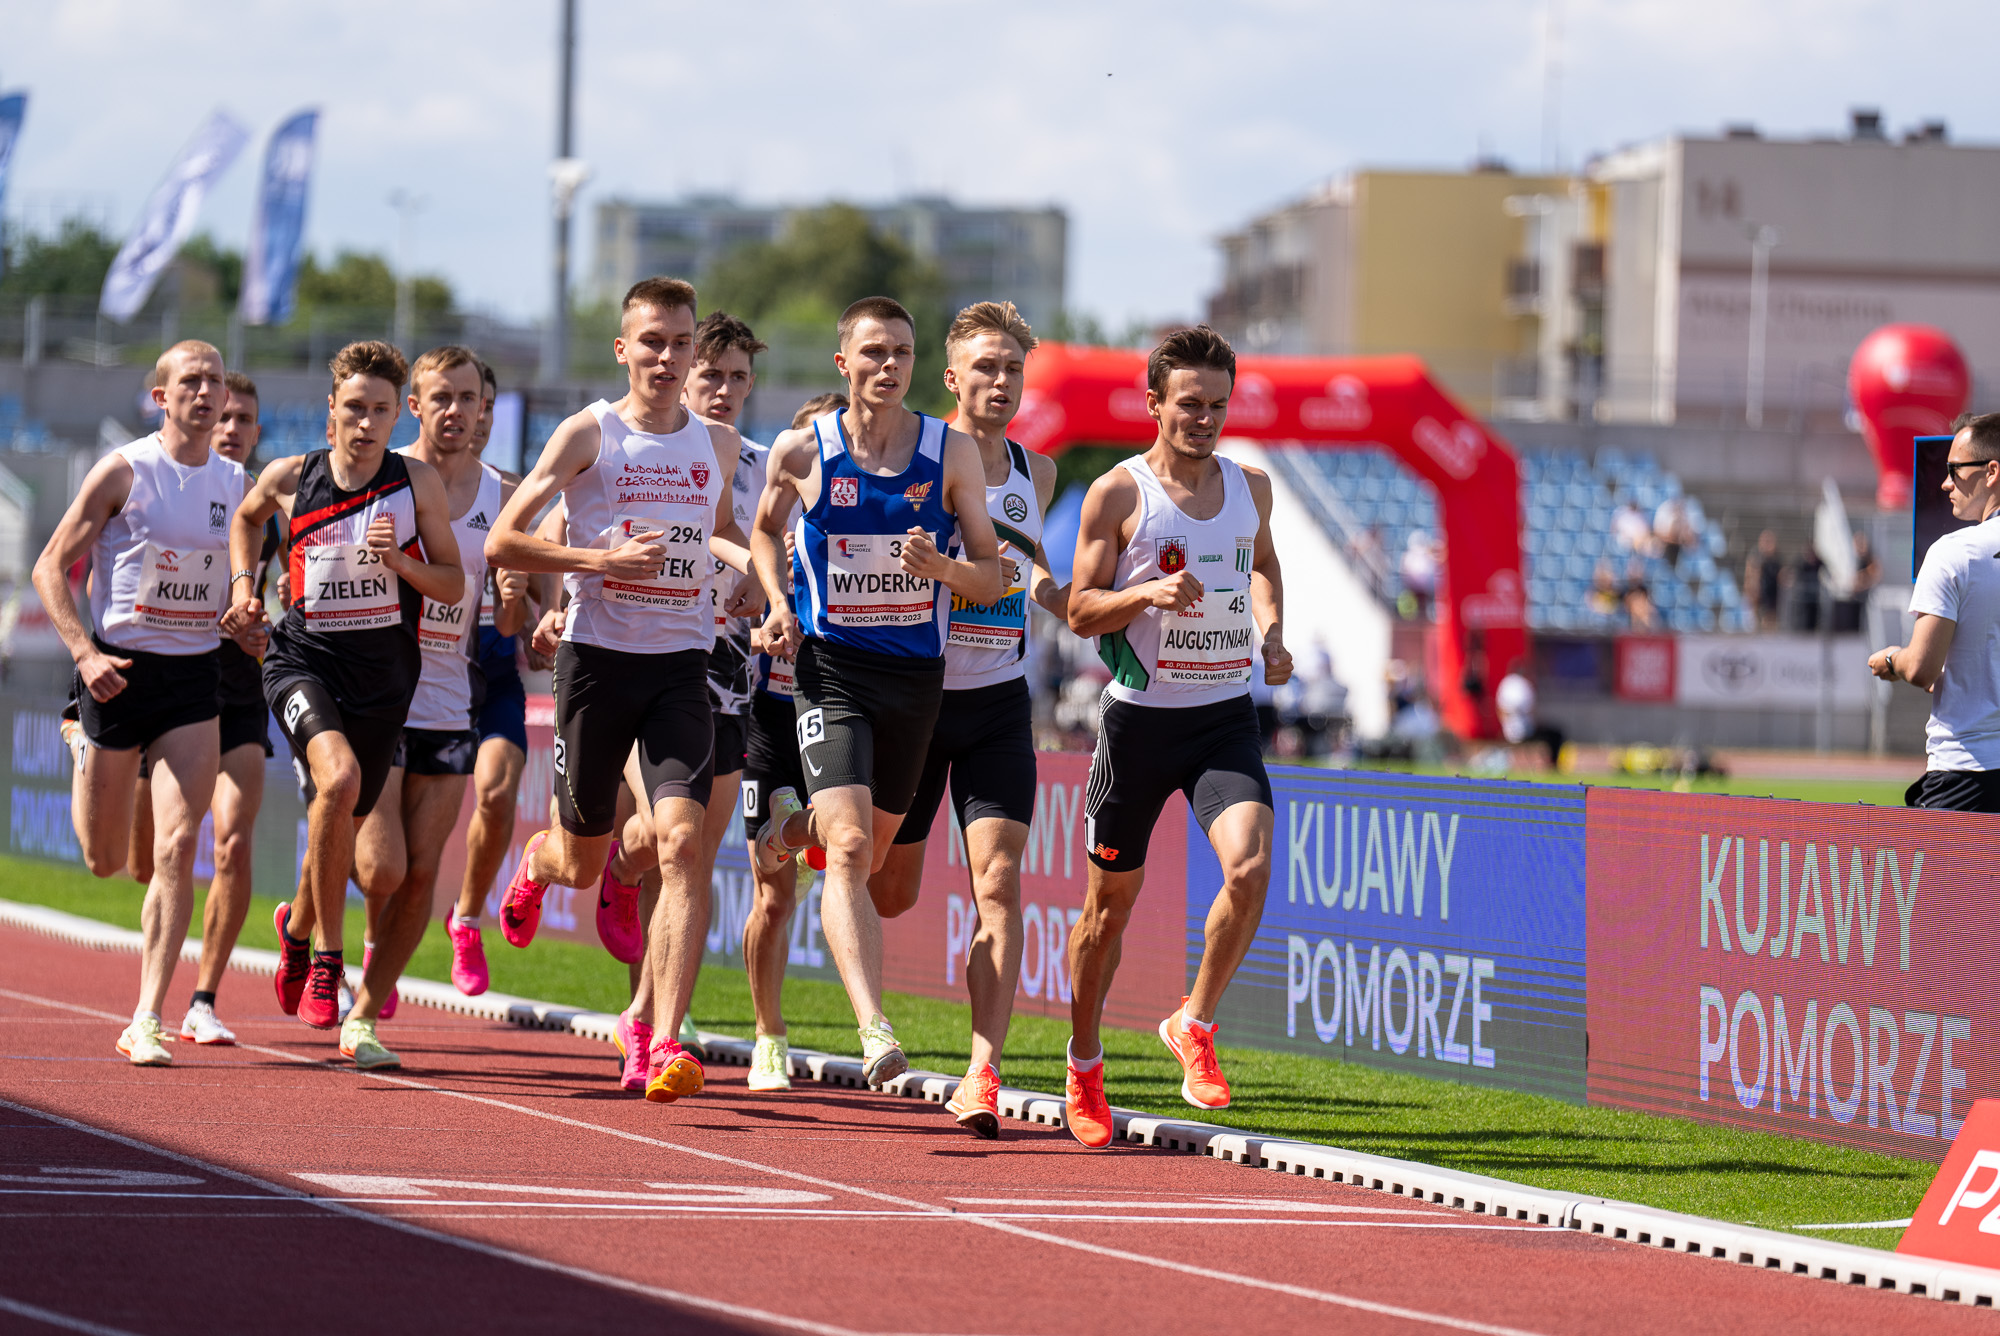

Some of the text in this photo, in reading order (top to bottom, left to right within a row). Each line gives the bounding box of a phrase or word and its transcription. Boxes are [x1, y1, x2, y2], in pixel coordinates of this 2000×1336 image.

[904, 480, 933, 497] AWF
[1006, 497, 1023, 509] RKS
[467, 522, 490, 532] adidas
[669, 526, 703, 545] 294
[890, 540, 901, 558] 3
[155, 563, 179, 572] ORLEN
[204, 554, 213, 571] 9
[657, 558, 696, 579] TEK
[157, 581, 210, 601] KULIK
[319, 573, 387, 600] ZIELEŃ
[636, 587, 671, 595] Mistrzostwa
[833, 572, 930, 593] WYDERKA
[615, 592, 670, 605] WŁOCŁAWEK
[1228, 595, 1245, 614] 45
[318, 615, 392, 628] WŁOCŁAWEK 2023
[336, 609, 370, 617] Mistrzostwa
[842, 613, 922, 623] WŁOCŁAWEK 2023
[145, 616, 193, 628] WŁOCŁAWEK
[959, 626, 994, 634] Mistrzostwa
[433, 641, 450, 649] 2023
[1165, 628, 1251, 651] AUGUSTYNIAK
[1192, 662, 1224, 670] Mistrzostwa
[1171, 670, 1242, 680] WŁOCŁAWEK 2023
[287, 698, 300, 723] 5
[798, 714, 822, 745] 15
[556, 743, 564, 769] 2
[1288, 800, 1460, 920] KUJAWY
[1700, 833, 1925, 971] KUJAWY
[1287, 934, 1495, 1069] POMORZE
[1700, 985, 1971, 1140] POMORZE
